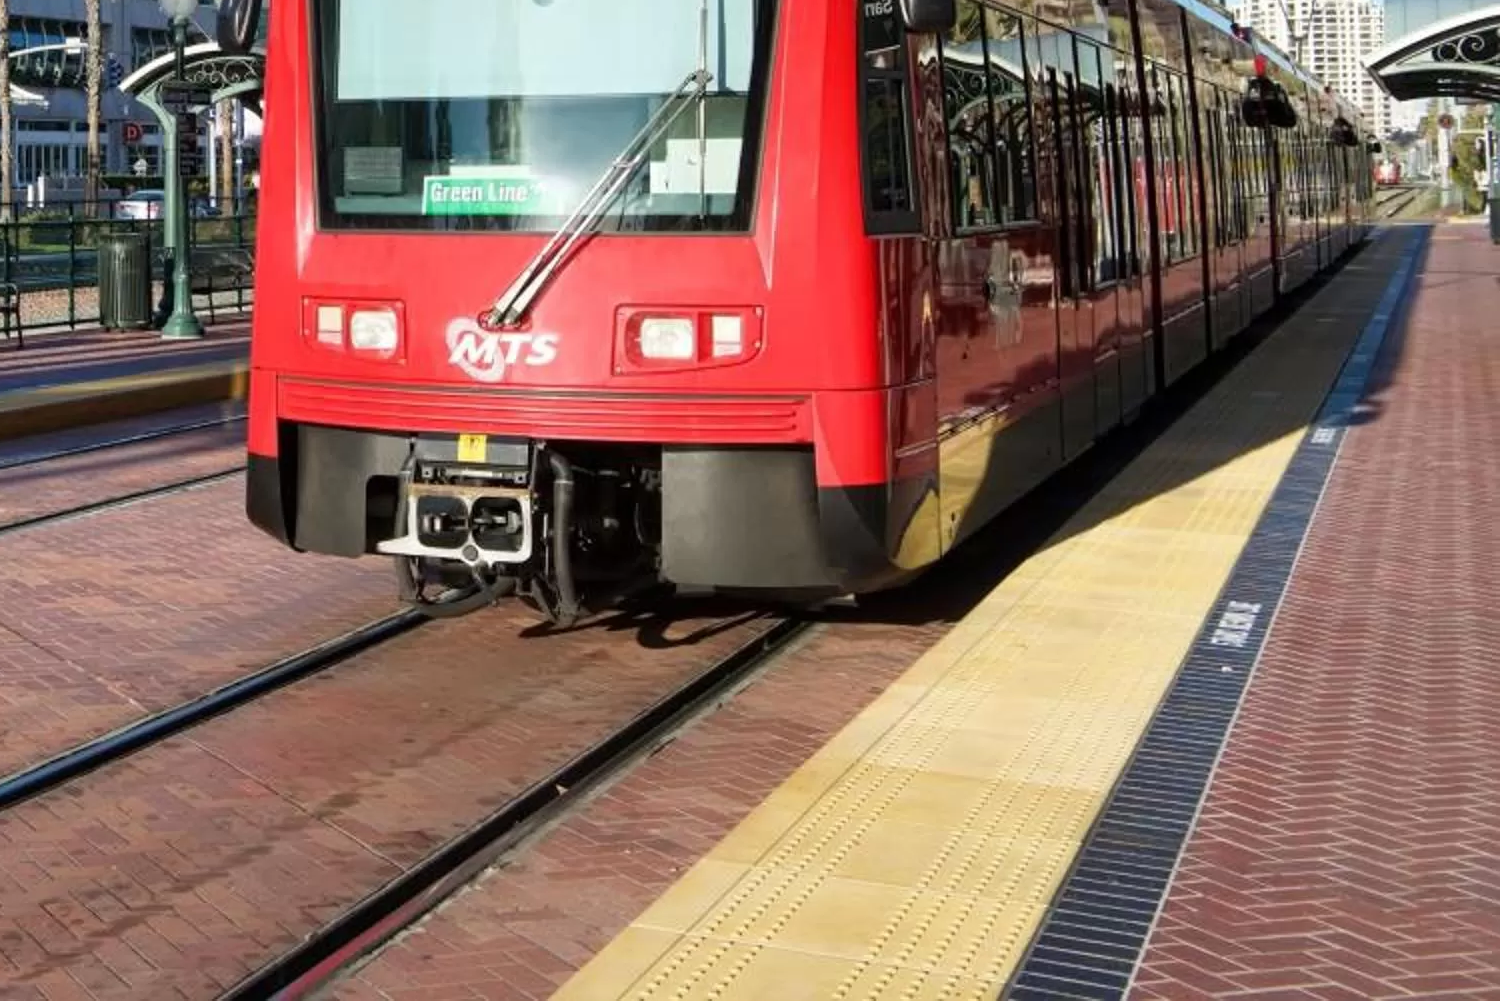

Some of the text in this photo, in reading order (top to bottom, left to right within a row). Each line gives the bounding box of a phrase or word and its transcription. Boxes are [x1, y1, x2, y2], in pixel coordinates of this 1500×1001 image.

[430, 181, 529, 203] Green Line
[447, 332, 560, 366] MTS
